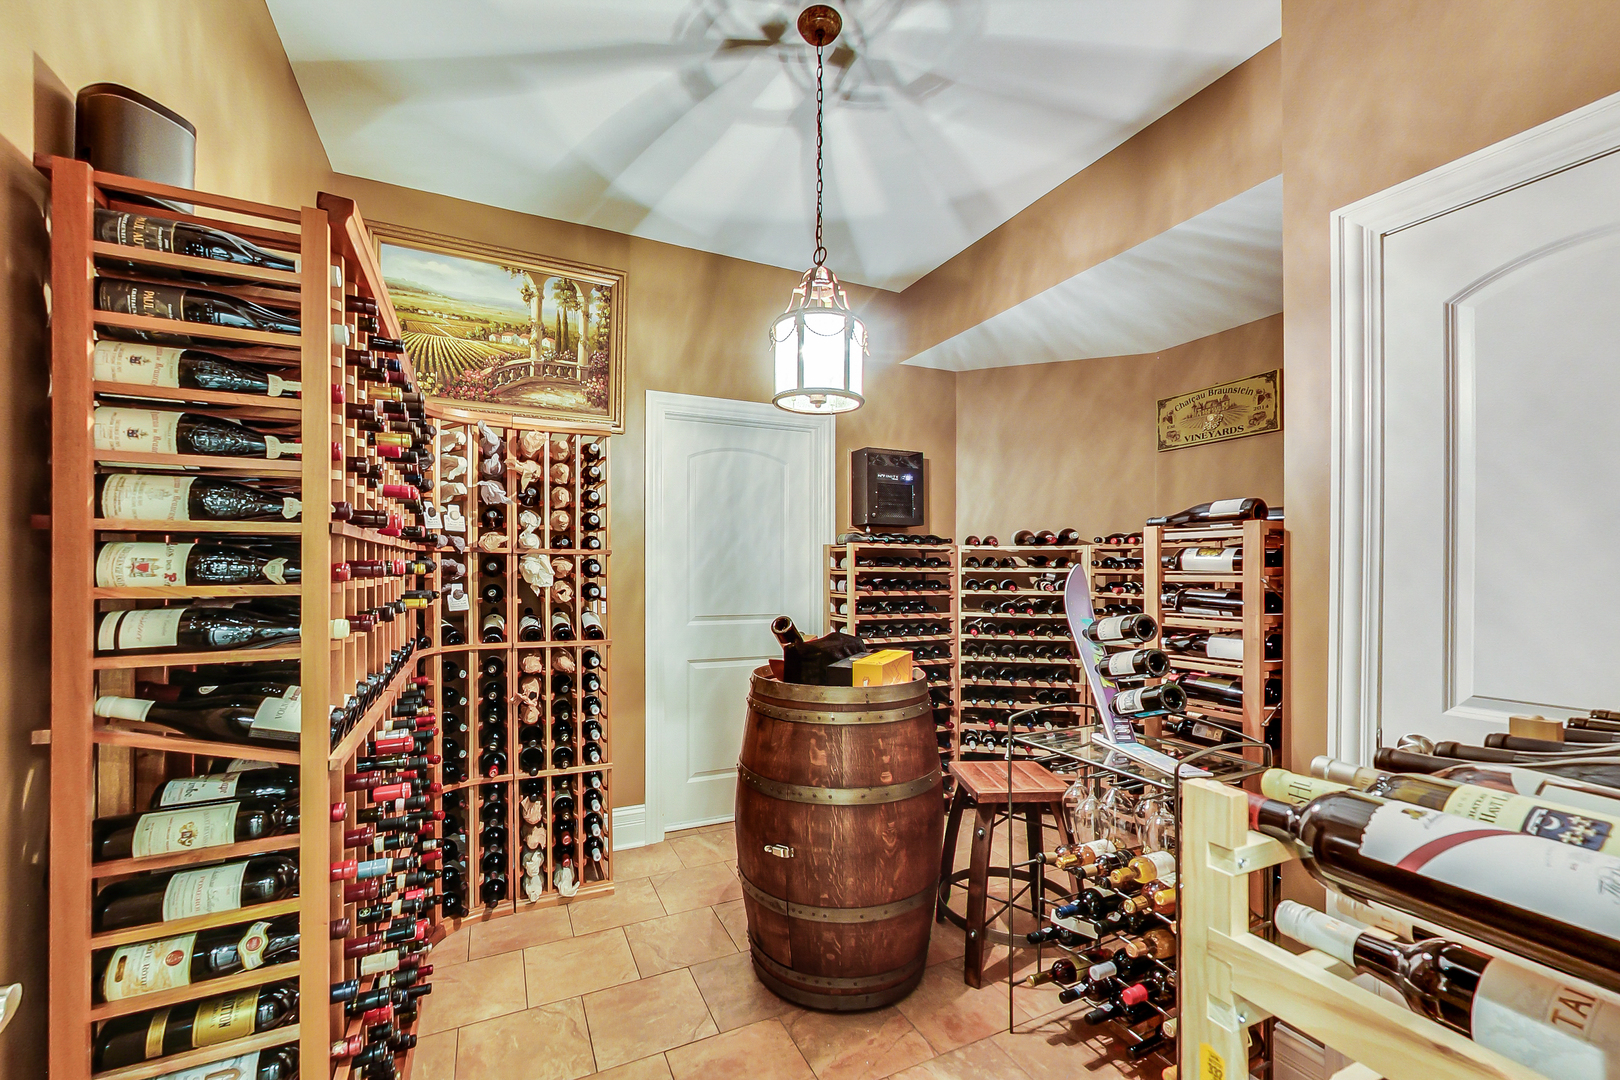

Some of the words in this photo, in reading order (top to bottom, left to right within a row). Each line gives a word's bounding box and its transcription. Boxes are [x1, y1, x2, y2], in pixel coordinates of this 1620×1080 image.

[143, 290, 155, 309] PAUL
[1174, 393, 1206, 412] Chateau
[1208, 386, 1254, 398] Braunstein
[1253, 404, 1270, 412] 2014
[1184, 425, 1245, 442] VINEYARDS
